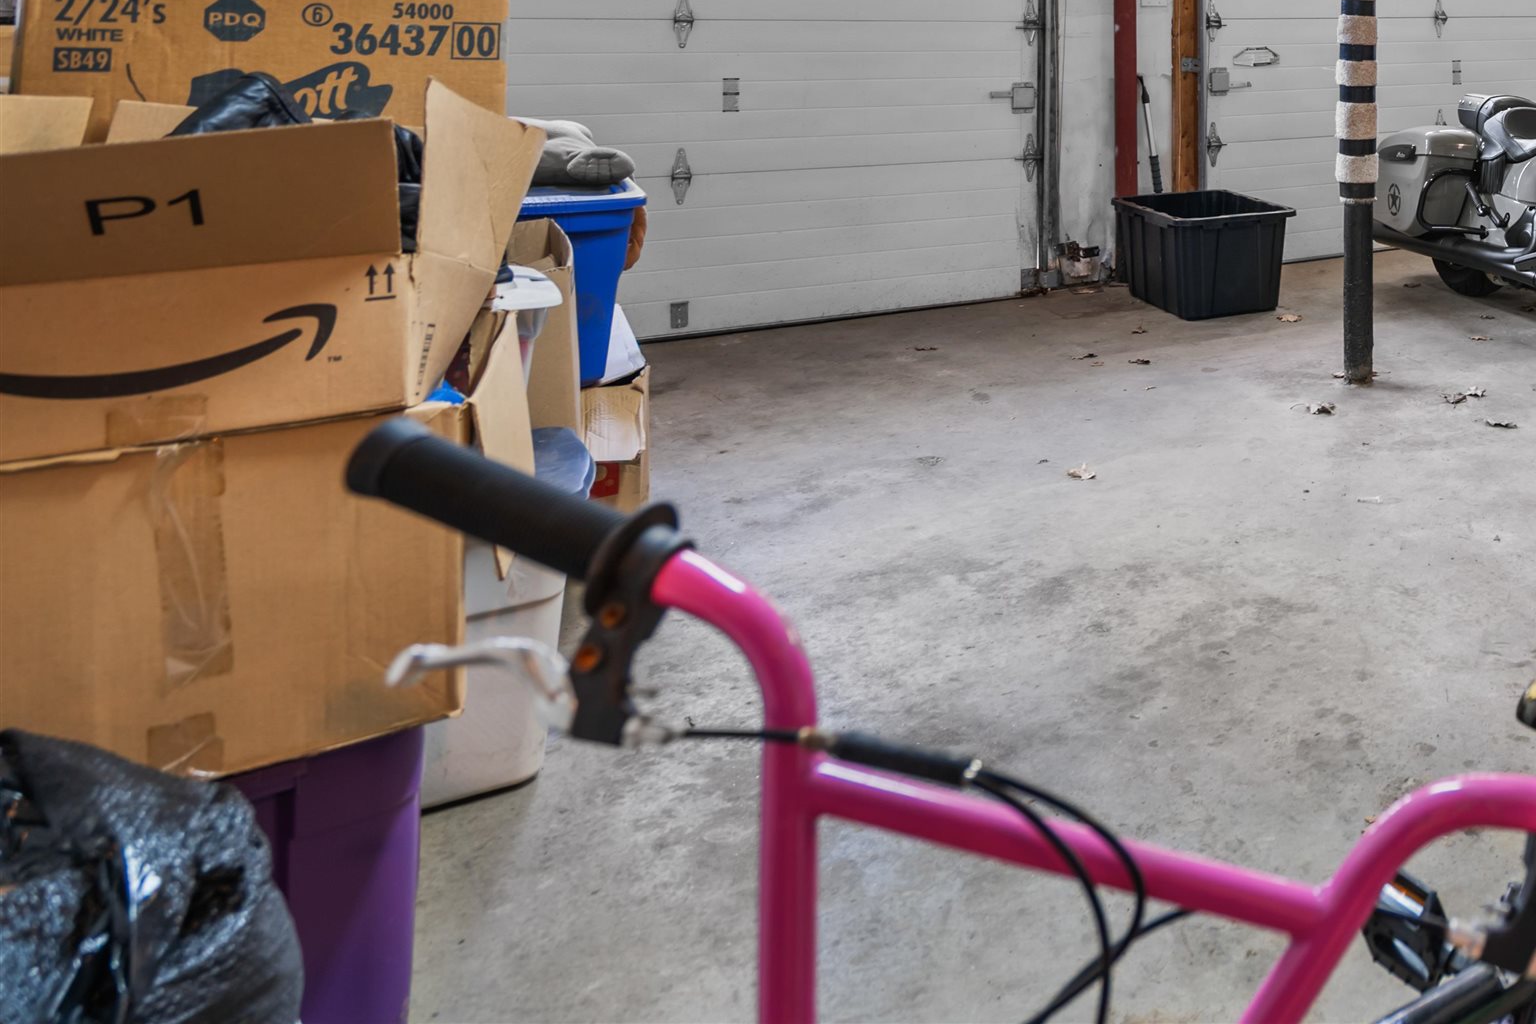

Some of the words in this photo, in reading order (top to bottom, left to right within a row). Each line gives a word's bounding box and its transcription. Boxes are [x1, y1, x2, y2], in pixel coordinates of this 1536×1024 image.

[208, 12, 262, 27] PDQ
[312, 6, 323, 23] 6
[392, 2, 454, 20] 54000
[56, 28, 124, 42] WHITE
[329, 22, 450, 56] 36437
[456, 25, 496, 57] 00
[56, 50, 109, 70] SB49
[294, 66, 359, 116] ott
[84, 188, 205, 236] P1
